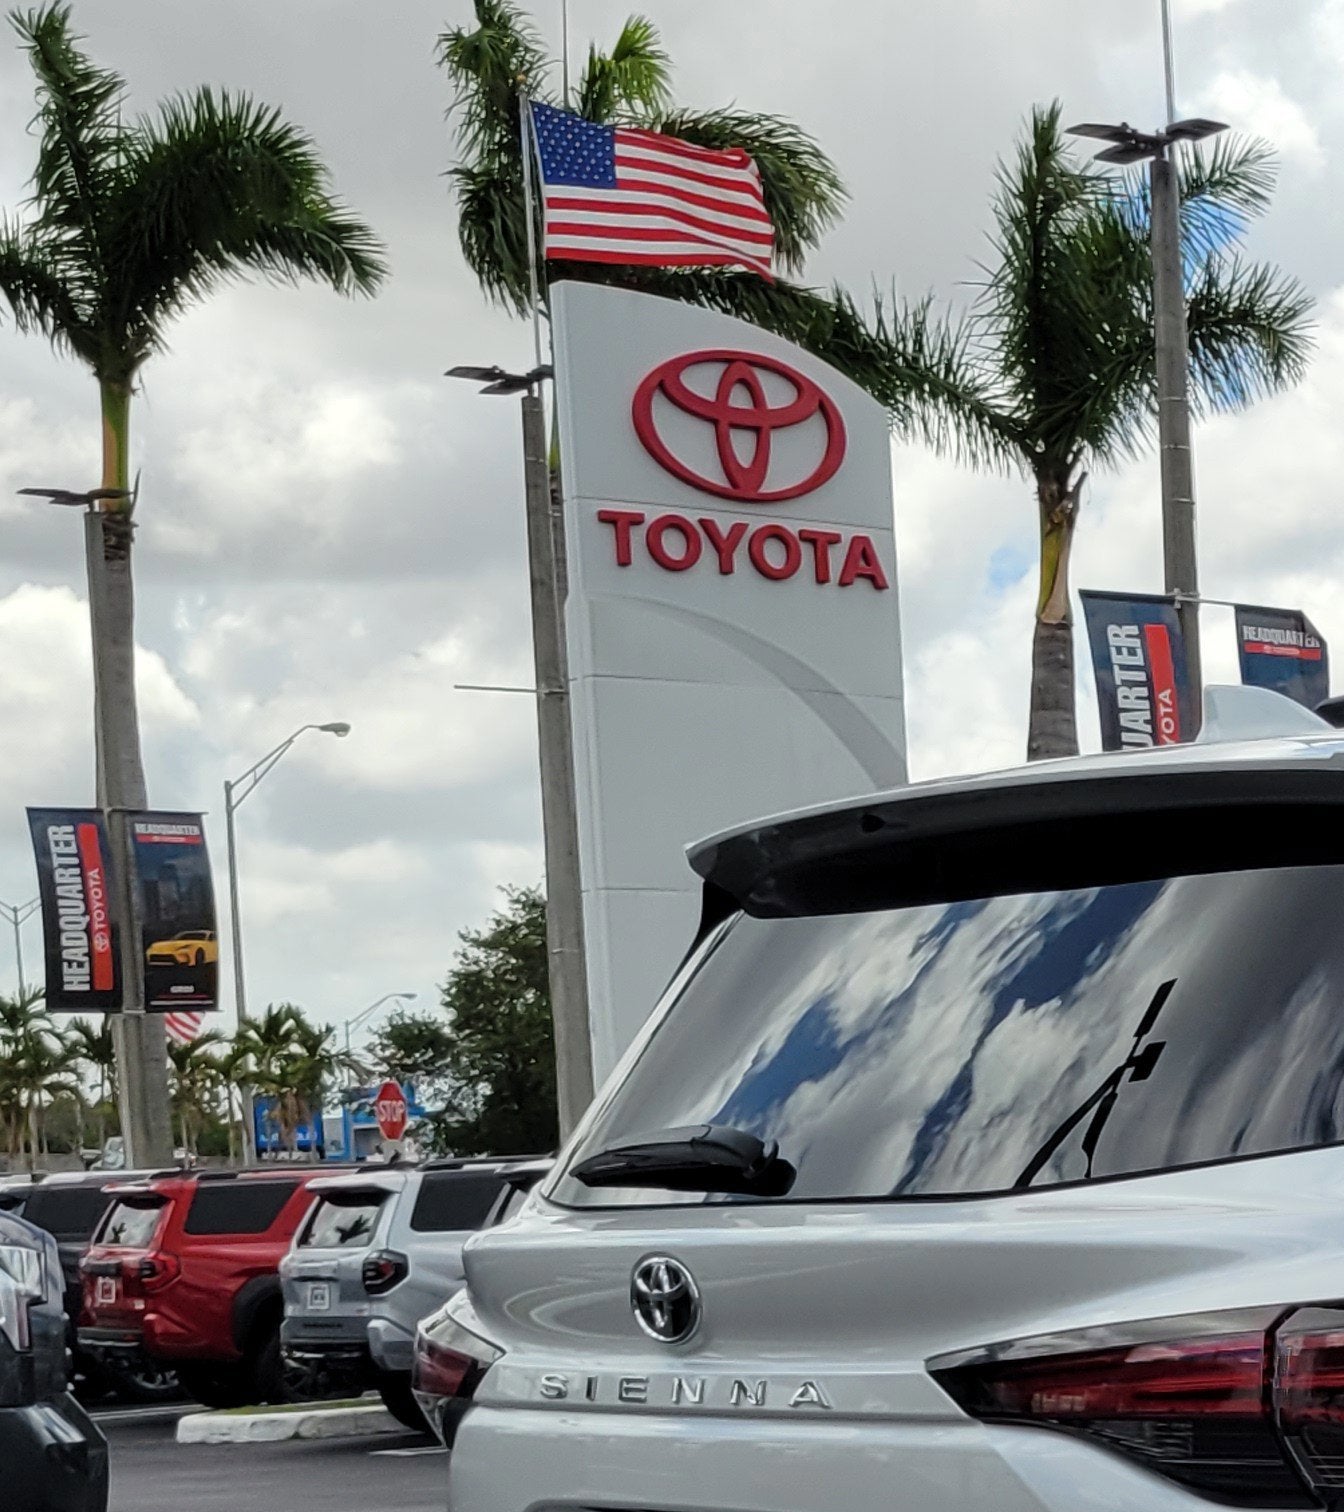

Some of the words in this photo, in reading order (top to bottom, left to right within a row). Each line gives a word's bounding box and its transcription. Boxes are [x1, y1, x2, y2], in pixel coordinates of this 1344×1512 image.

[597, 510, 889, 590] TOYOTA
[48, 825, 91, 991] HEADQUARTER
[87, 868, 106, 931] TOYOTA
[378, 1100, 405, 1122] STOP
[540, 1373, 833, 1409] SIENNA
